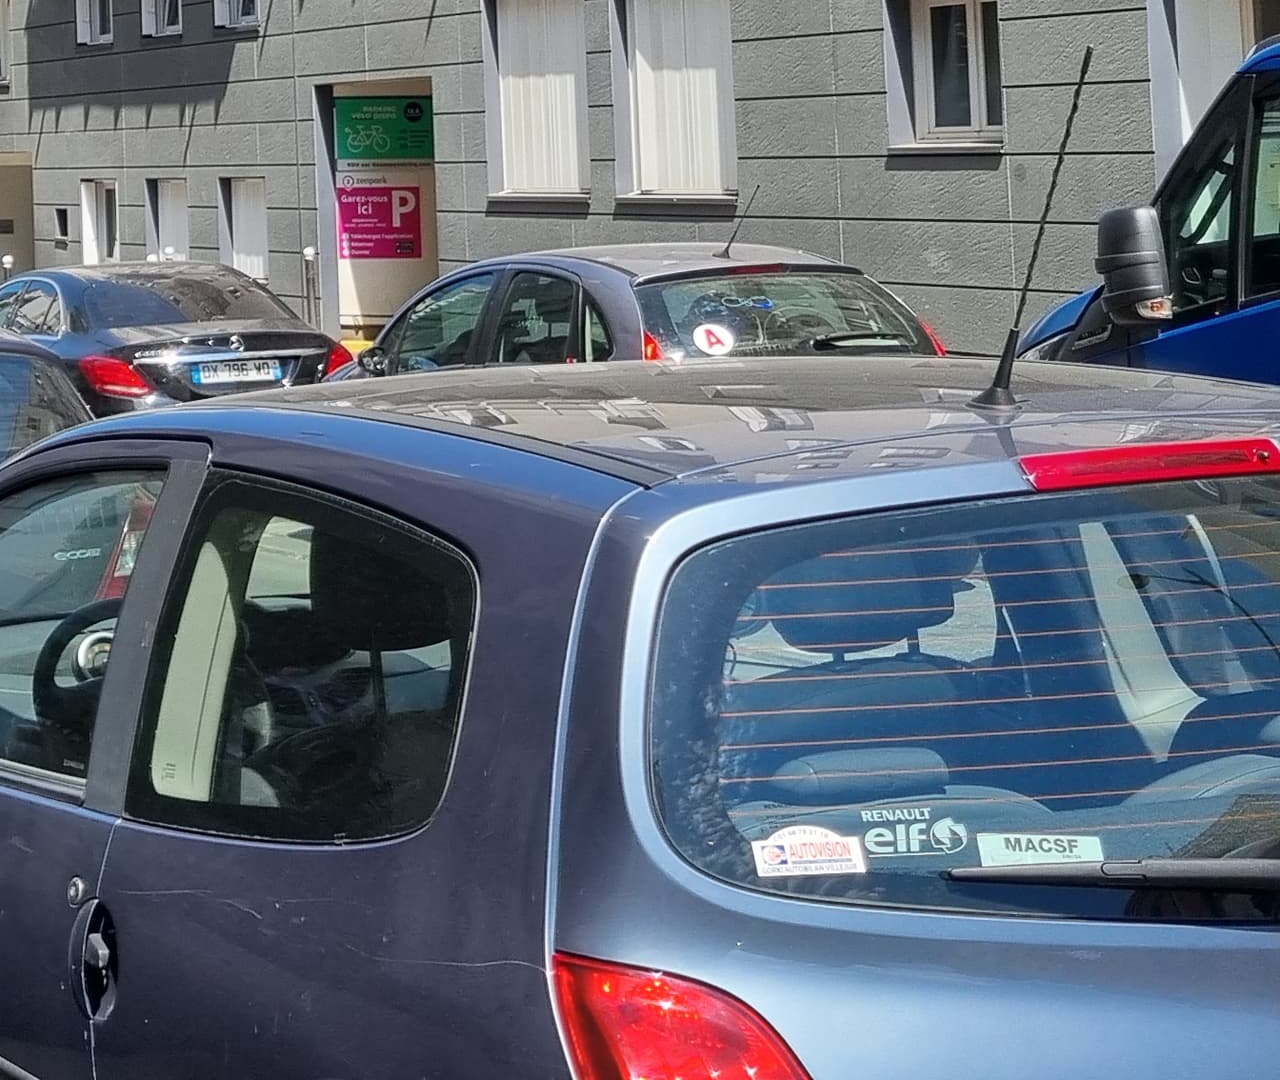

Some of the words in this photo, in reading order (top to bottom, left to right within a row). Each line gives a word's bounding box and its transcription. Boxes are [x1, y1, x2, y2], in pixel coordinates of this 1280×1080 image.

[356, 176, 388, 186] zenpark
[341, 194, 388, 203] Garez-vous
[357, 201, 372, 215] ici
[391, 190, 416, 228] P
[703, 328, 726, 350] A
[861, 807, 931, 822] RENAULT
[864, 822, 928, 853] elf
[1004, 837, 1078, 855] MACSF
[789, 841, 852, 859] AUTOVISION
